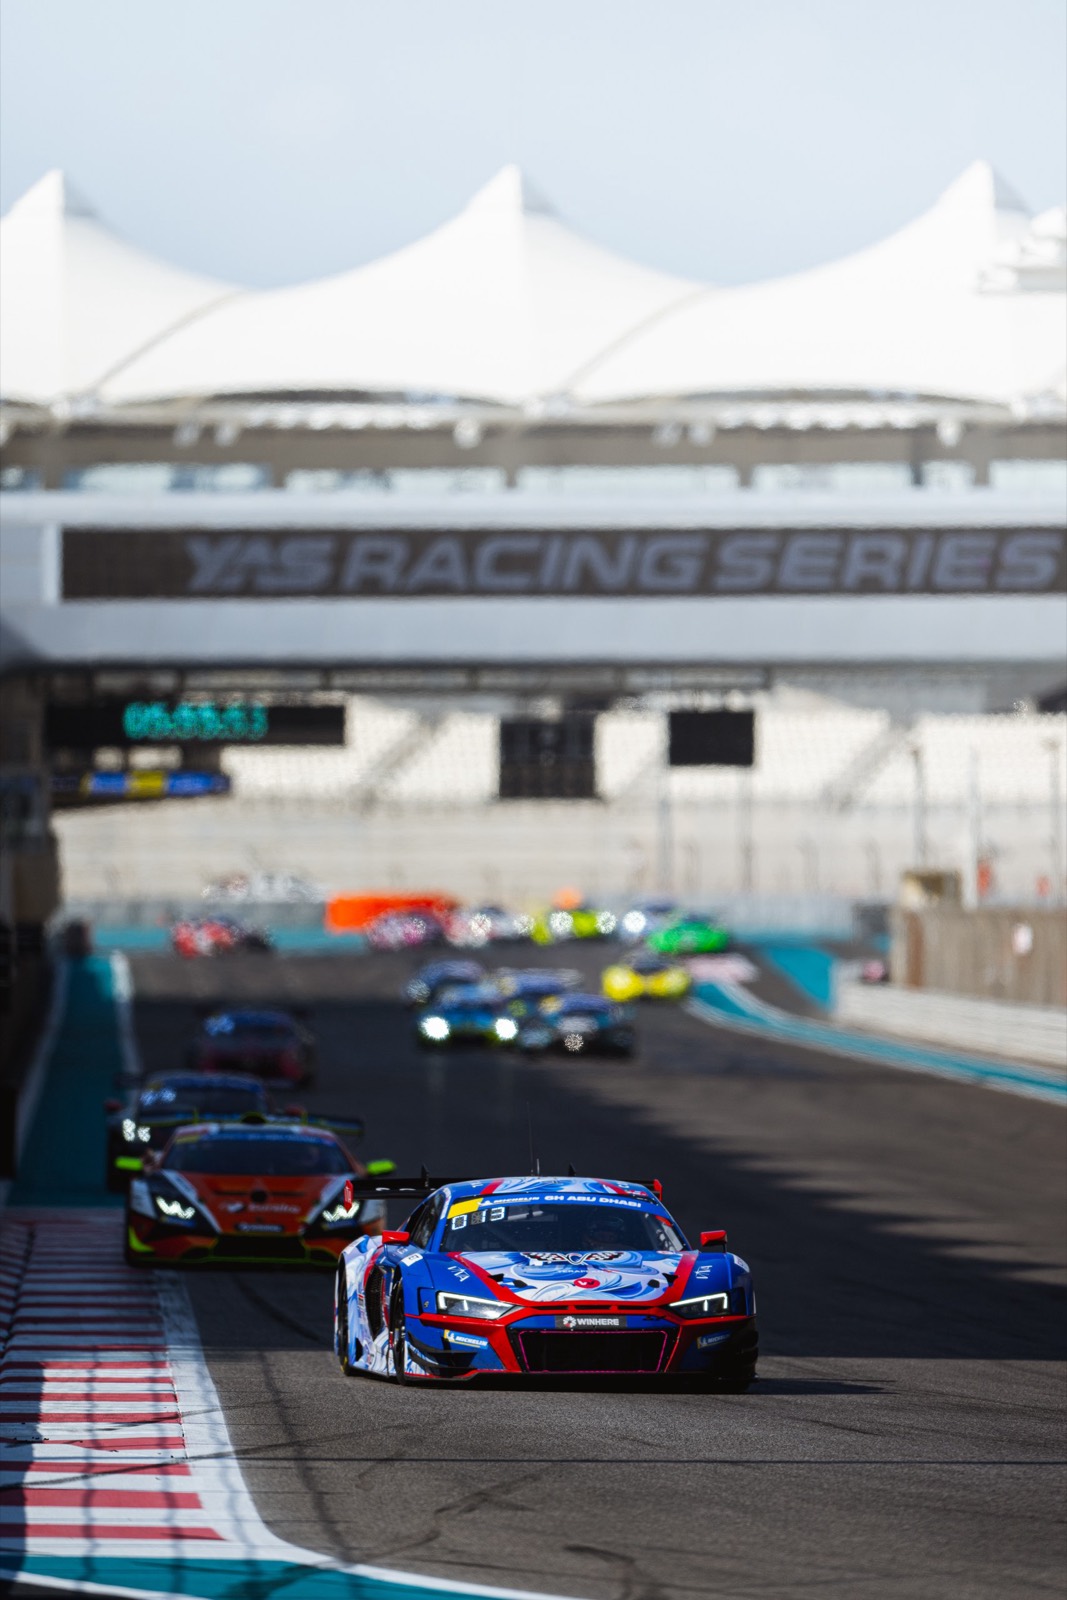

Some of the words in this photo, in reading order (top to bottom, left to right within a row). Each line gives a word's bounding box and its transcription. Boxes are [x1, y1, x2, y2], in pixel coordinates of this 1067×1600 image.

[186, 536, 335, 591] YAS
[342, 535, 708, 590] RACING
[713, 534, 1061, 589] SERIES
[599, 1196, 642, 1208] DHABI
[577, 1318, 620, 1326] WINHERE
